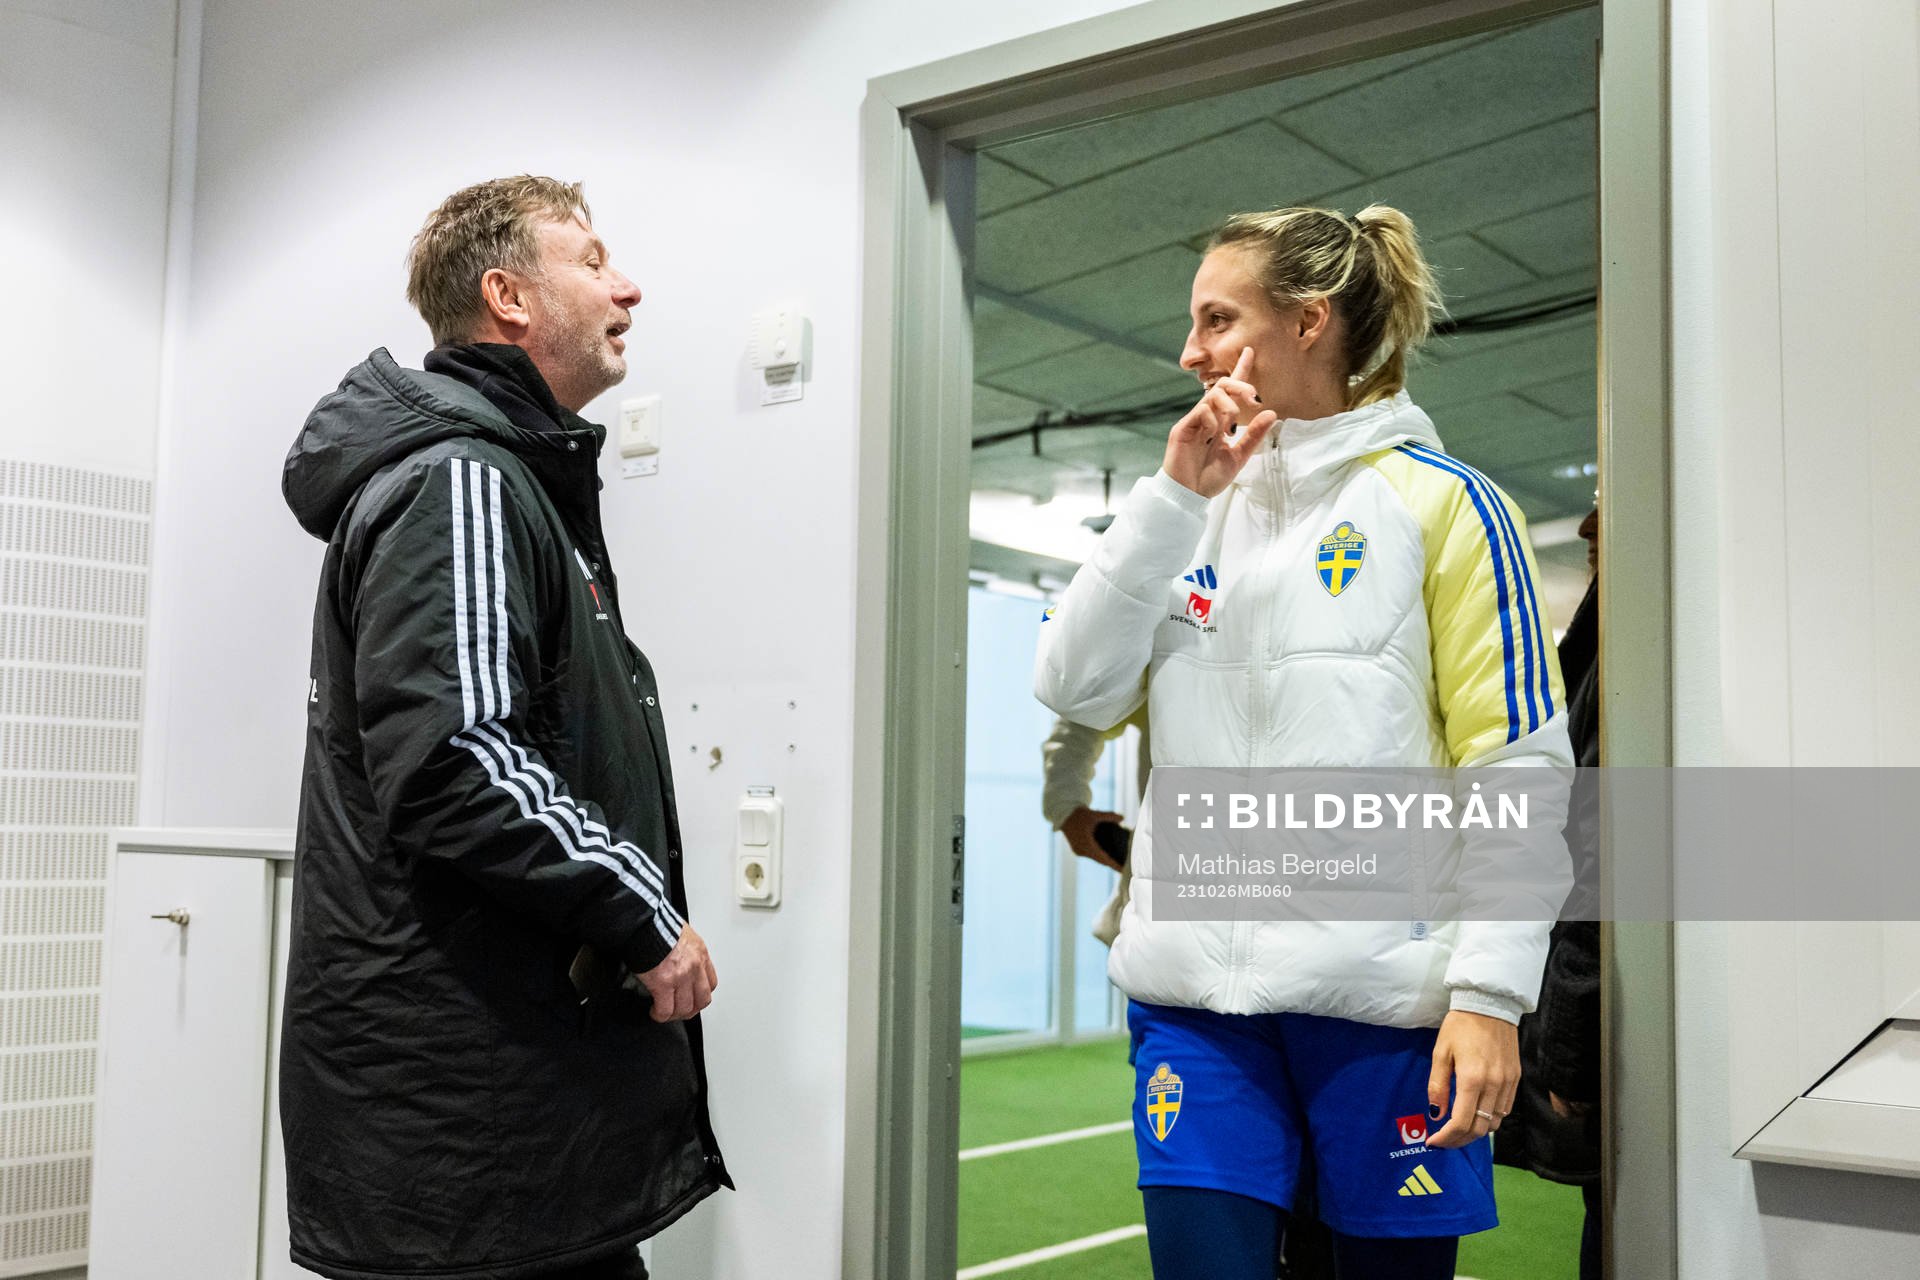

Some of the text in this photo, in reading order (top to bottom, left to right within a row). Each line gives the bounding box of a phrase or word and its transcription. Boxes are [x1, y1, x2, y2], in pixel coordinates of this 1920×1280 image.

[1323, 542, 1359, 550] SVERIGE
[1169, 614, 1201, 629] SVENSKA
[1389, 1146, 1427, 1159] SVENSKA
